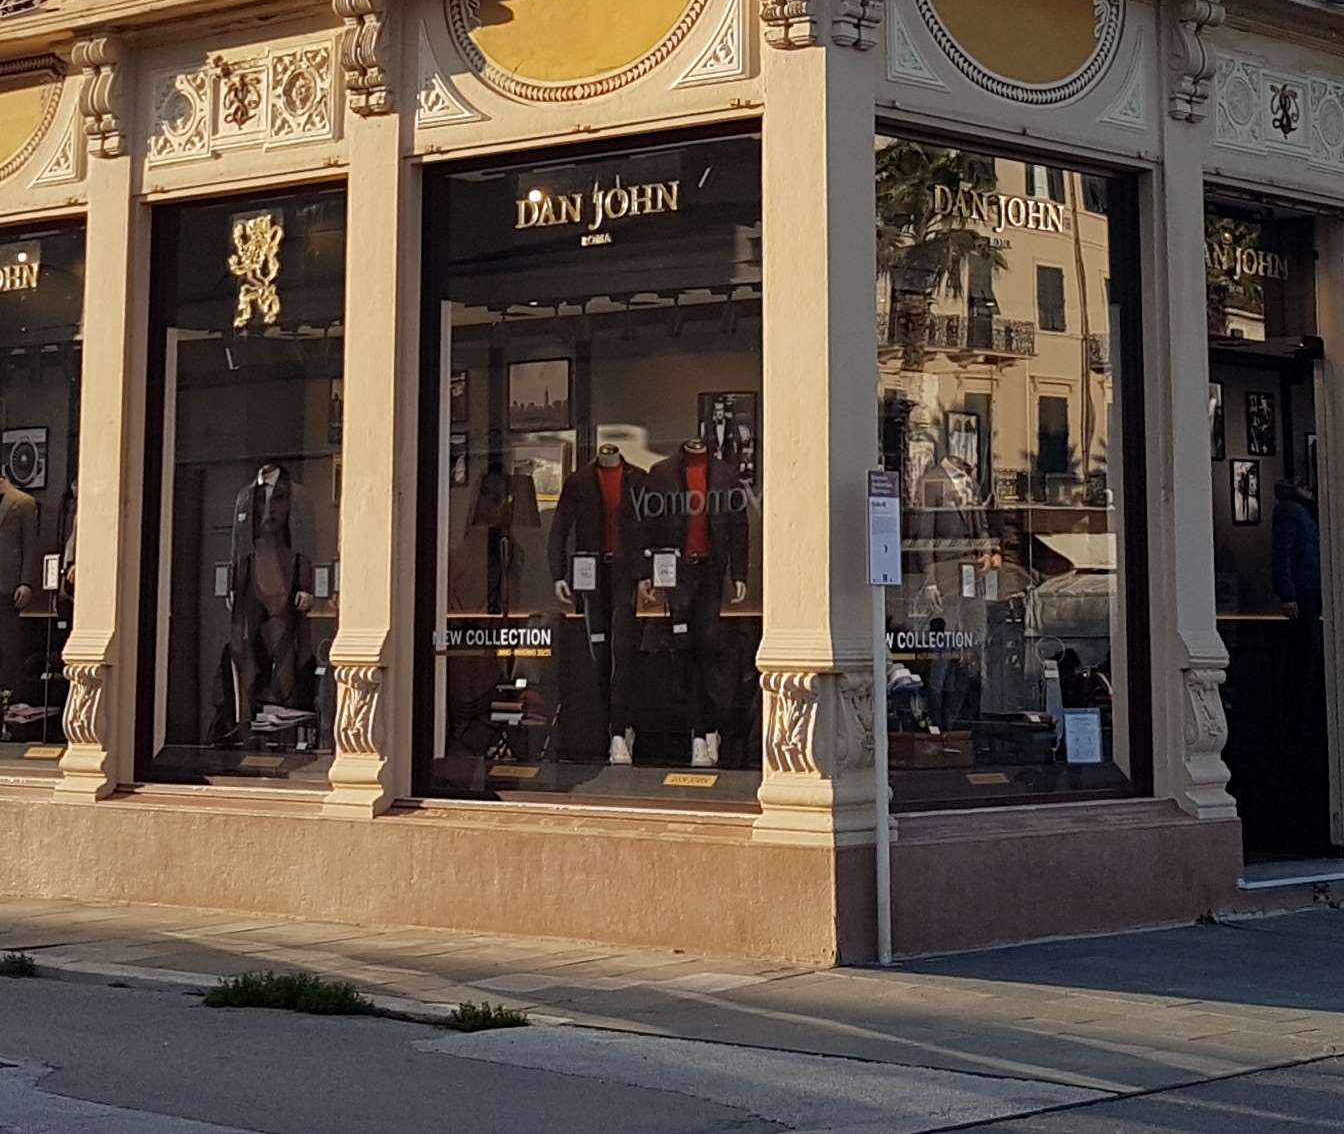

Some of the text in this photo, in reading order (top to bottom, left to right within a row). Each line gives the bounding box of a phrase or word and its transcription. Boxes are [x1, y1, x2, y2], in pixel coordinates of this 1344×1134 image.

[514, 180, 680, 231] DAN JOHN
[934, 183, 1065, 234] DAN JOHN
[1233, 247, 1289, 281] JOHN
[466, 628, 552, 646] COLLECTION
[897, 631, 973, 649] COLLECTION
